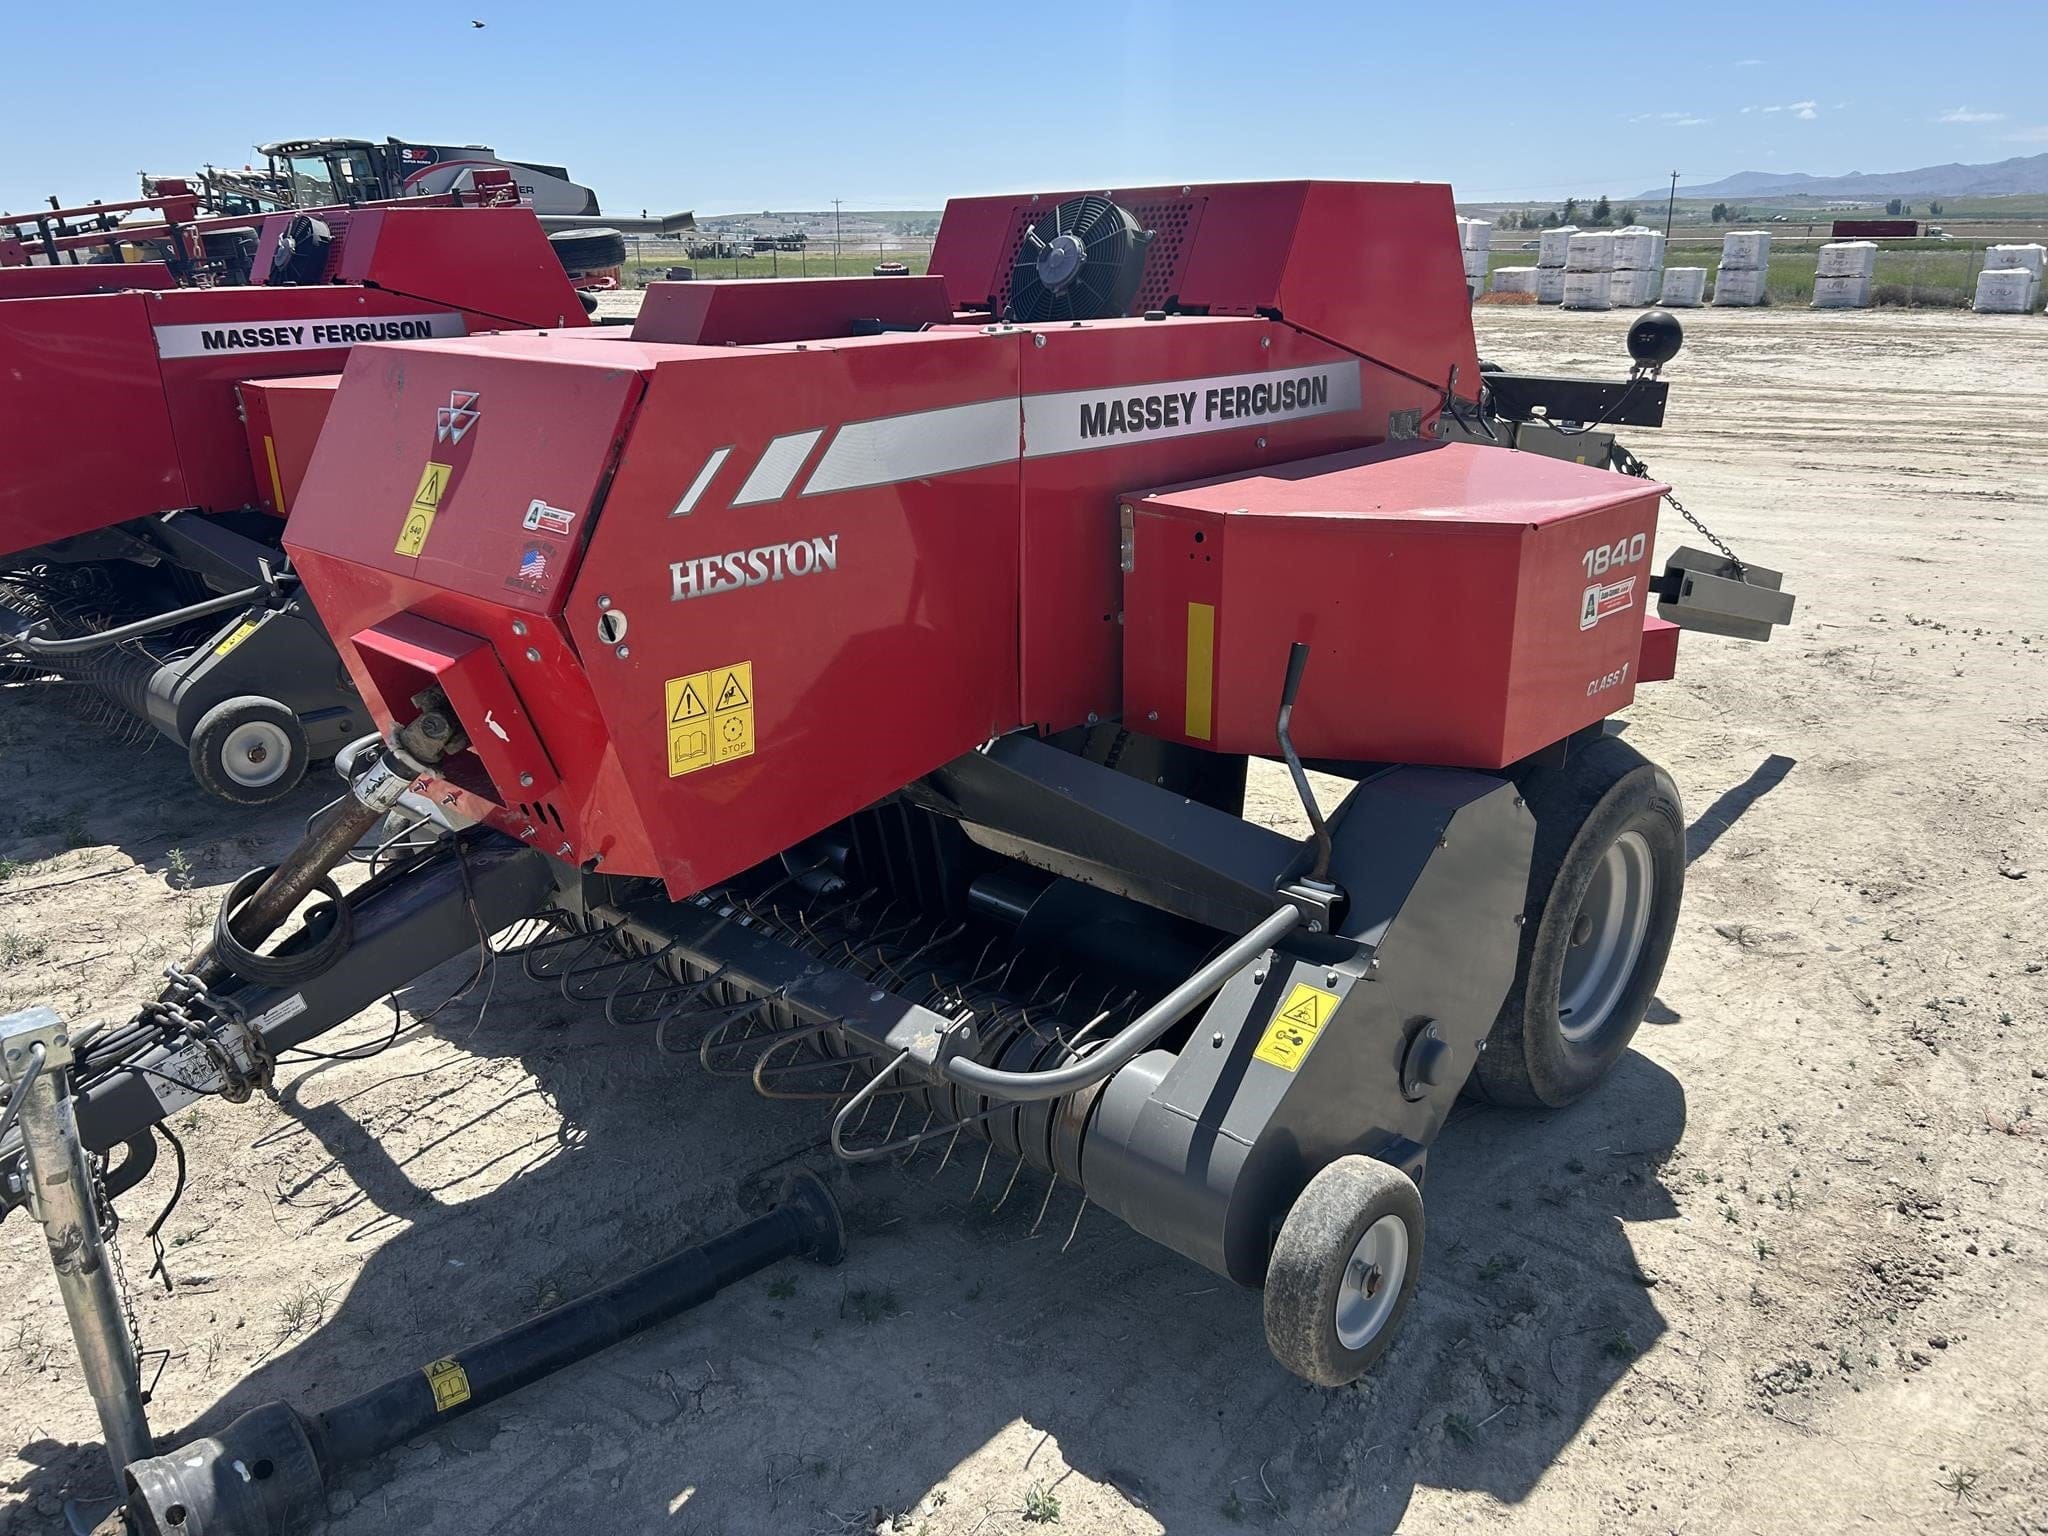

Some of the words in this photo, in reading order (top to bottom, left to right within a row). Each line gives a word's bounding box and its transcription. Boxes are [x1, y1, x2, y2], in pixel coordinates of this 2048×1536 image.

[202, 326, 304, 350] MASSEY
[312, 320, 433, 344] FERGUSON
[1080, 392, 1197, 438] MASSEY
[1204, 375, 1328, 421] FERGUSON
[409, 526, 422, 535] 540
[669, 534, 839, 602] HESSTON
[1582, 532, 1646, 579] 1840
[1586, 668, 1621, 697] CLASS
[1620, 662, 1630, 685] 1
[721, 741, 747, 756] STOP
